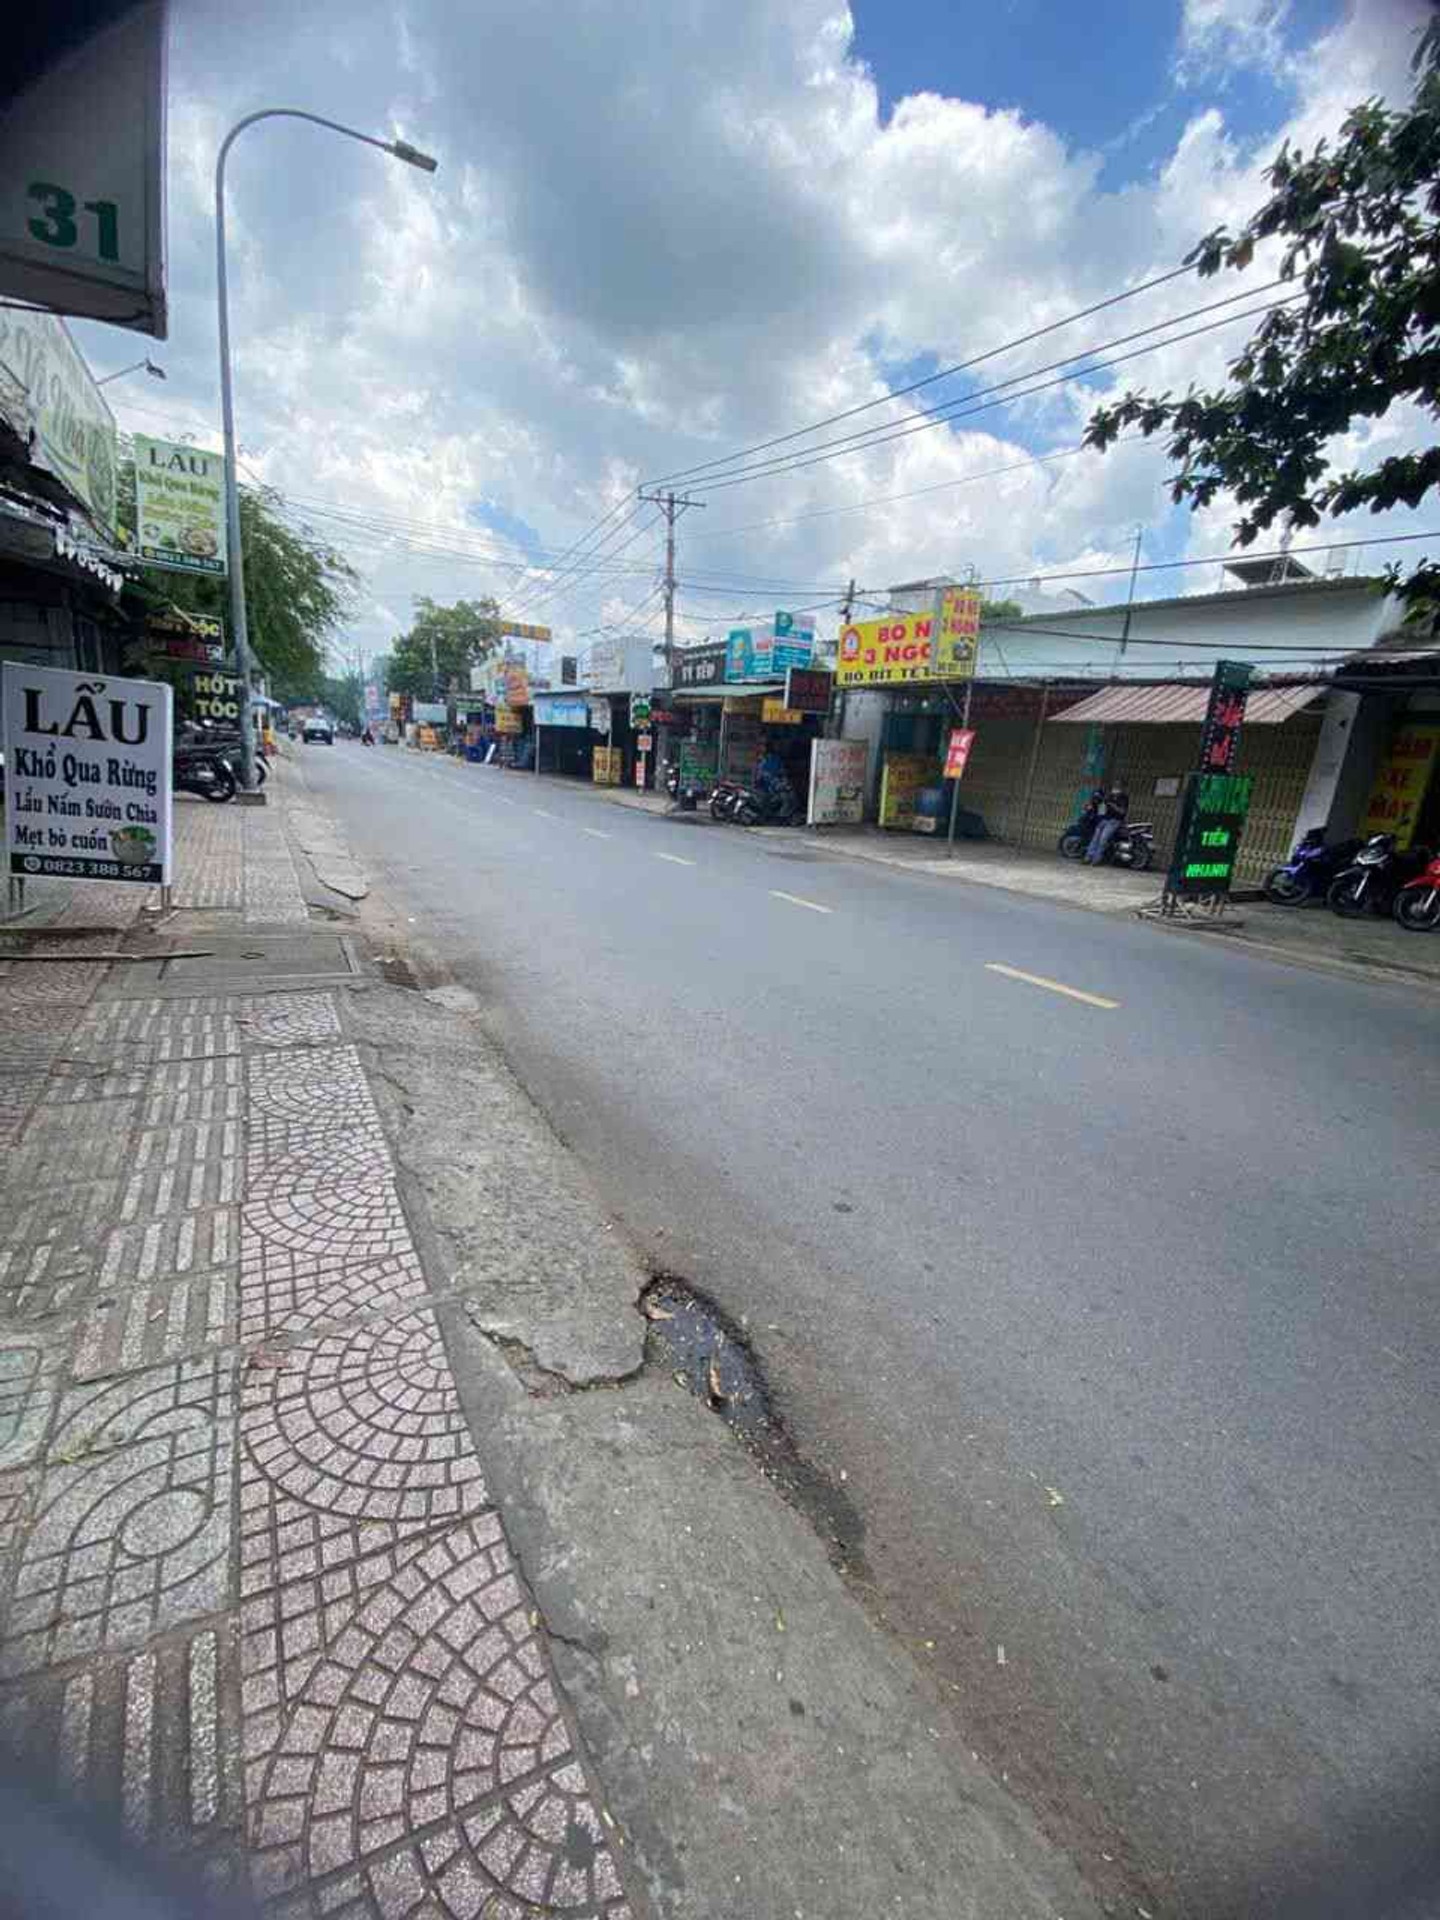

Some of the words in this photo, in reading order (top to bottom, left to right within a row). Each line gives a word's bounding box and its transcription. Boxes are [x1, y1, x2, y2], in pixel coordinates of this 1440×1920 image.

[27, 181, 119, 262] 31
[915, 621, 931, 637] N
[23, 682, 151, 745] LẨU
[195, 696, 238, 719] TÓC
[15, 742, 56, 778] Khổ
[63, 754, 100, 787] Qua
[107, 758, 157, 796] Rừng
